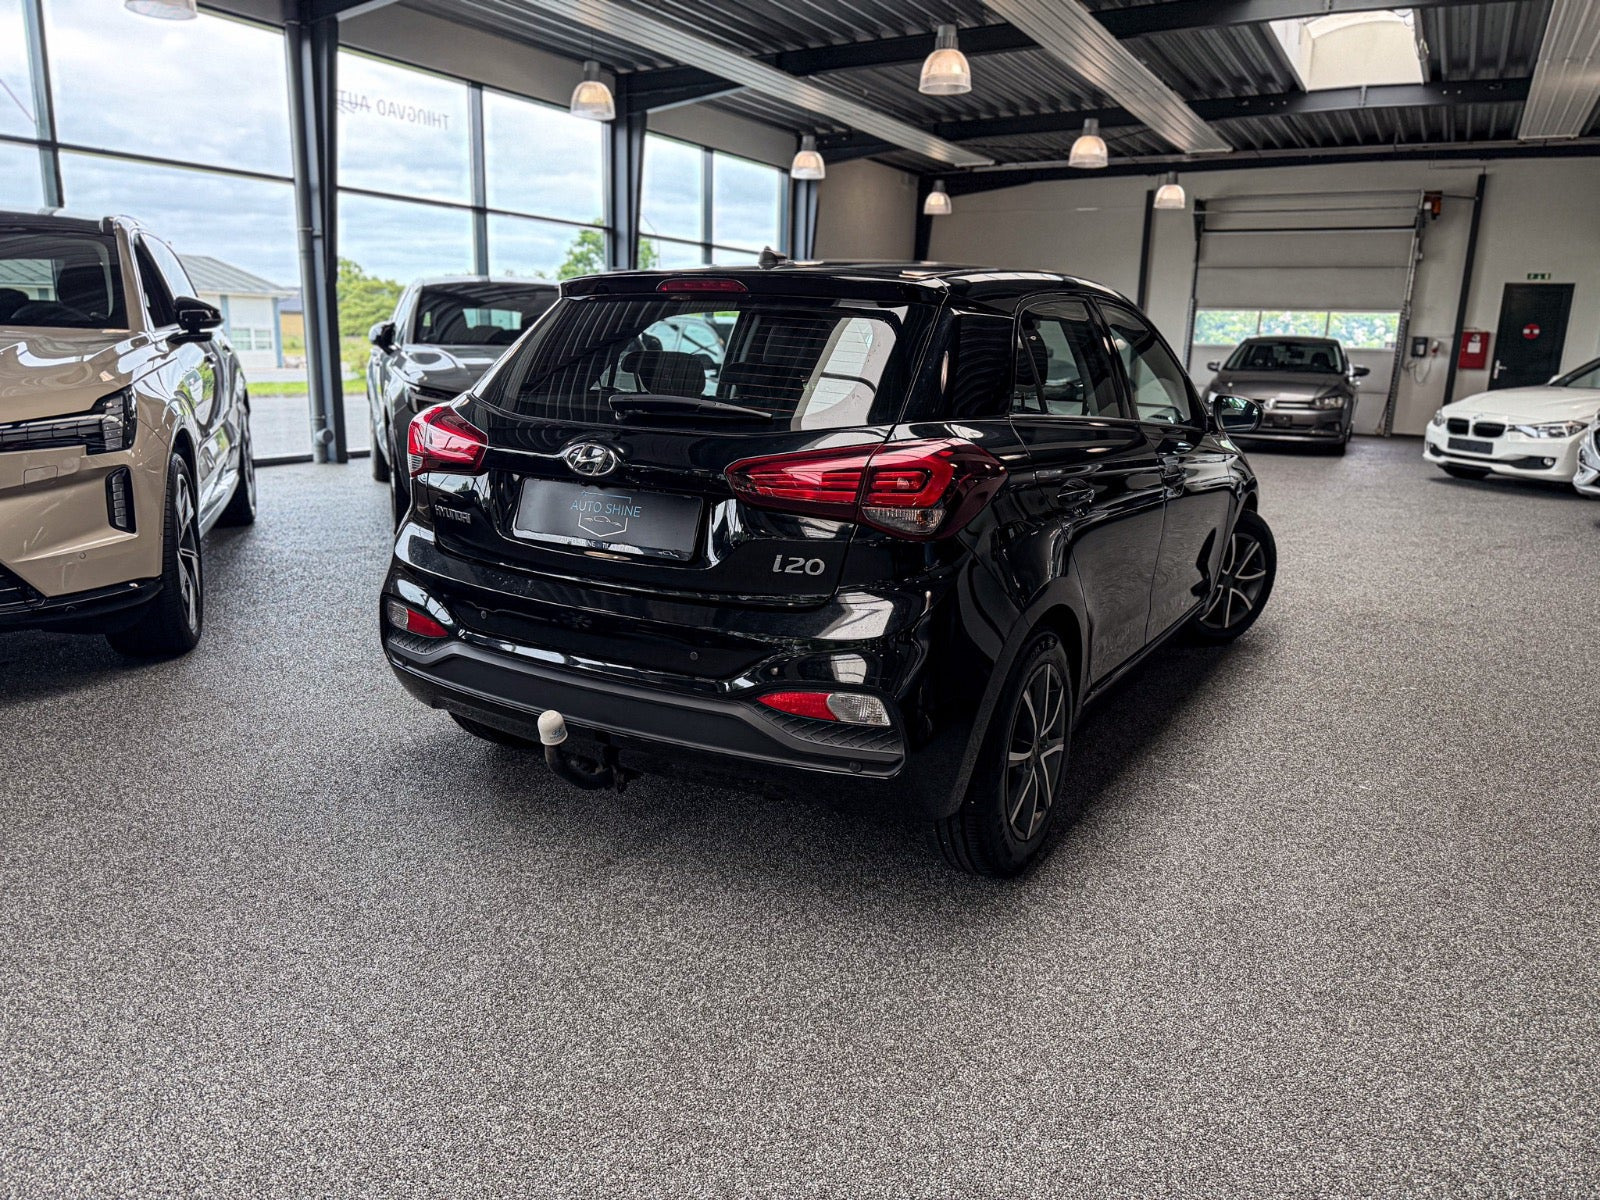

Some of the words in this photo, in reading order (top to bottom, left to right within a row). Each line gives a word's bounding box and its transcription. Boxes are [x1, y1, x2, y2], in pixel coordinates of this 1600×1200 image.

[570, 499, 603, 513] AUTO
[605, 502, 643, 518] SHINE
[772, 554, 826, 576] i20
